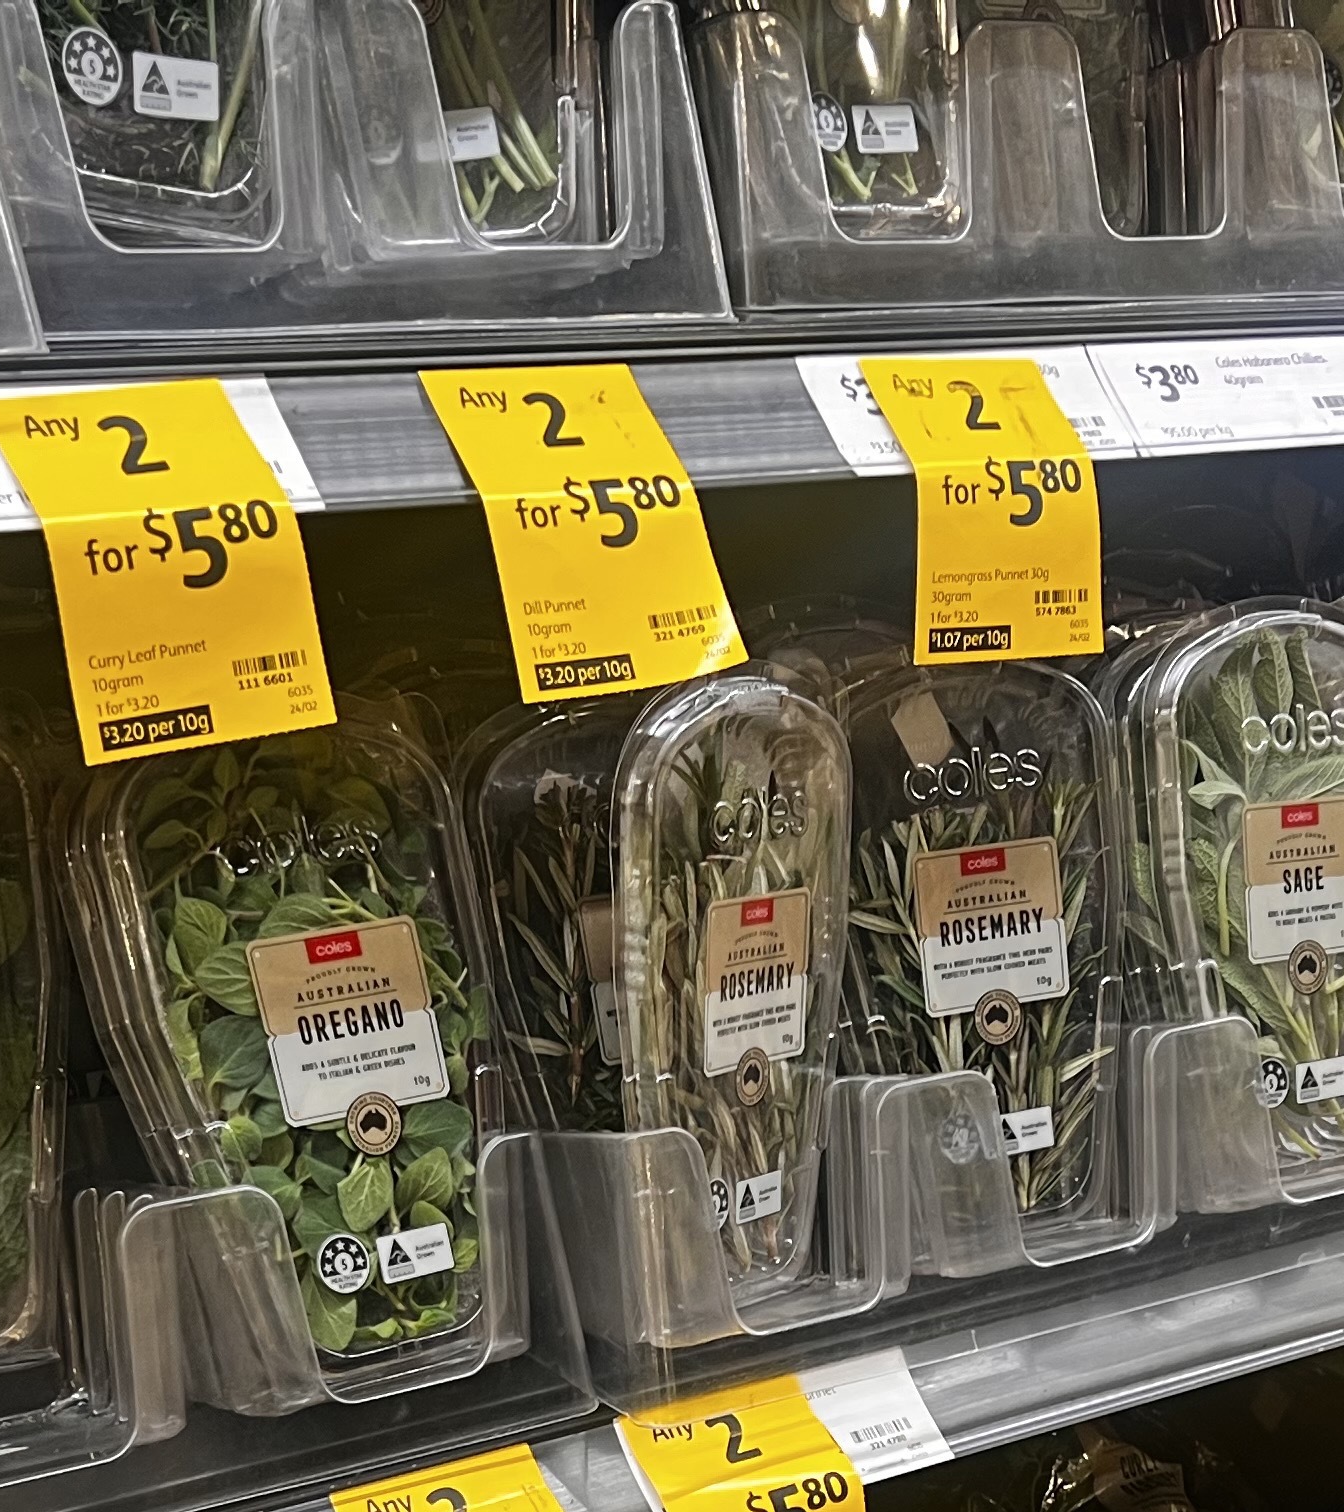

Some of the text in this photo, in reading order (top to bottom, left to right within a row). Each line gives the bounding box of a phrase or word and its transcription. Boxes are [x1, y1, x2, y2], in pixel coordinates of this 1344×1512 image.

[459, 387, 585, 447] Any 2
[892, 374, 1000, 430] Any 2
[24, 414, 170, 475] Any 2
[942, 476, 981, 505] for
[515, 498, 561, 530] for
[84, 539, 138, 575] for
[932, 566, 1050, 586] Lemongrass Punnet 30g
[524, 598, 587, 616] Dill Punnet
[931, 589, 972, 604] 30gram
[88, 639, 207, 672] Curry Leaf Punnet
[931, 629, 1009, 651] $1.07 per 10g
[904, 746, 1042, 802] coles
[1283, 866, 1325, 894] SAGE
[947, 889, 1027, 909] AUSTRALIAN
[939, 907, 1045, 947] ROSEMARY
[315, 939, 353, 957] coles
[297, 977, 391, 1003] AUSTRALIAN
[720, 962, 794, 1003] ROSEMARY
[297, 999, 405, 1045] OREGANO
[652, 1413, 763, 1464] Any 2
